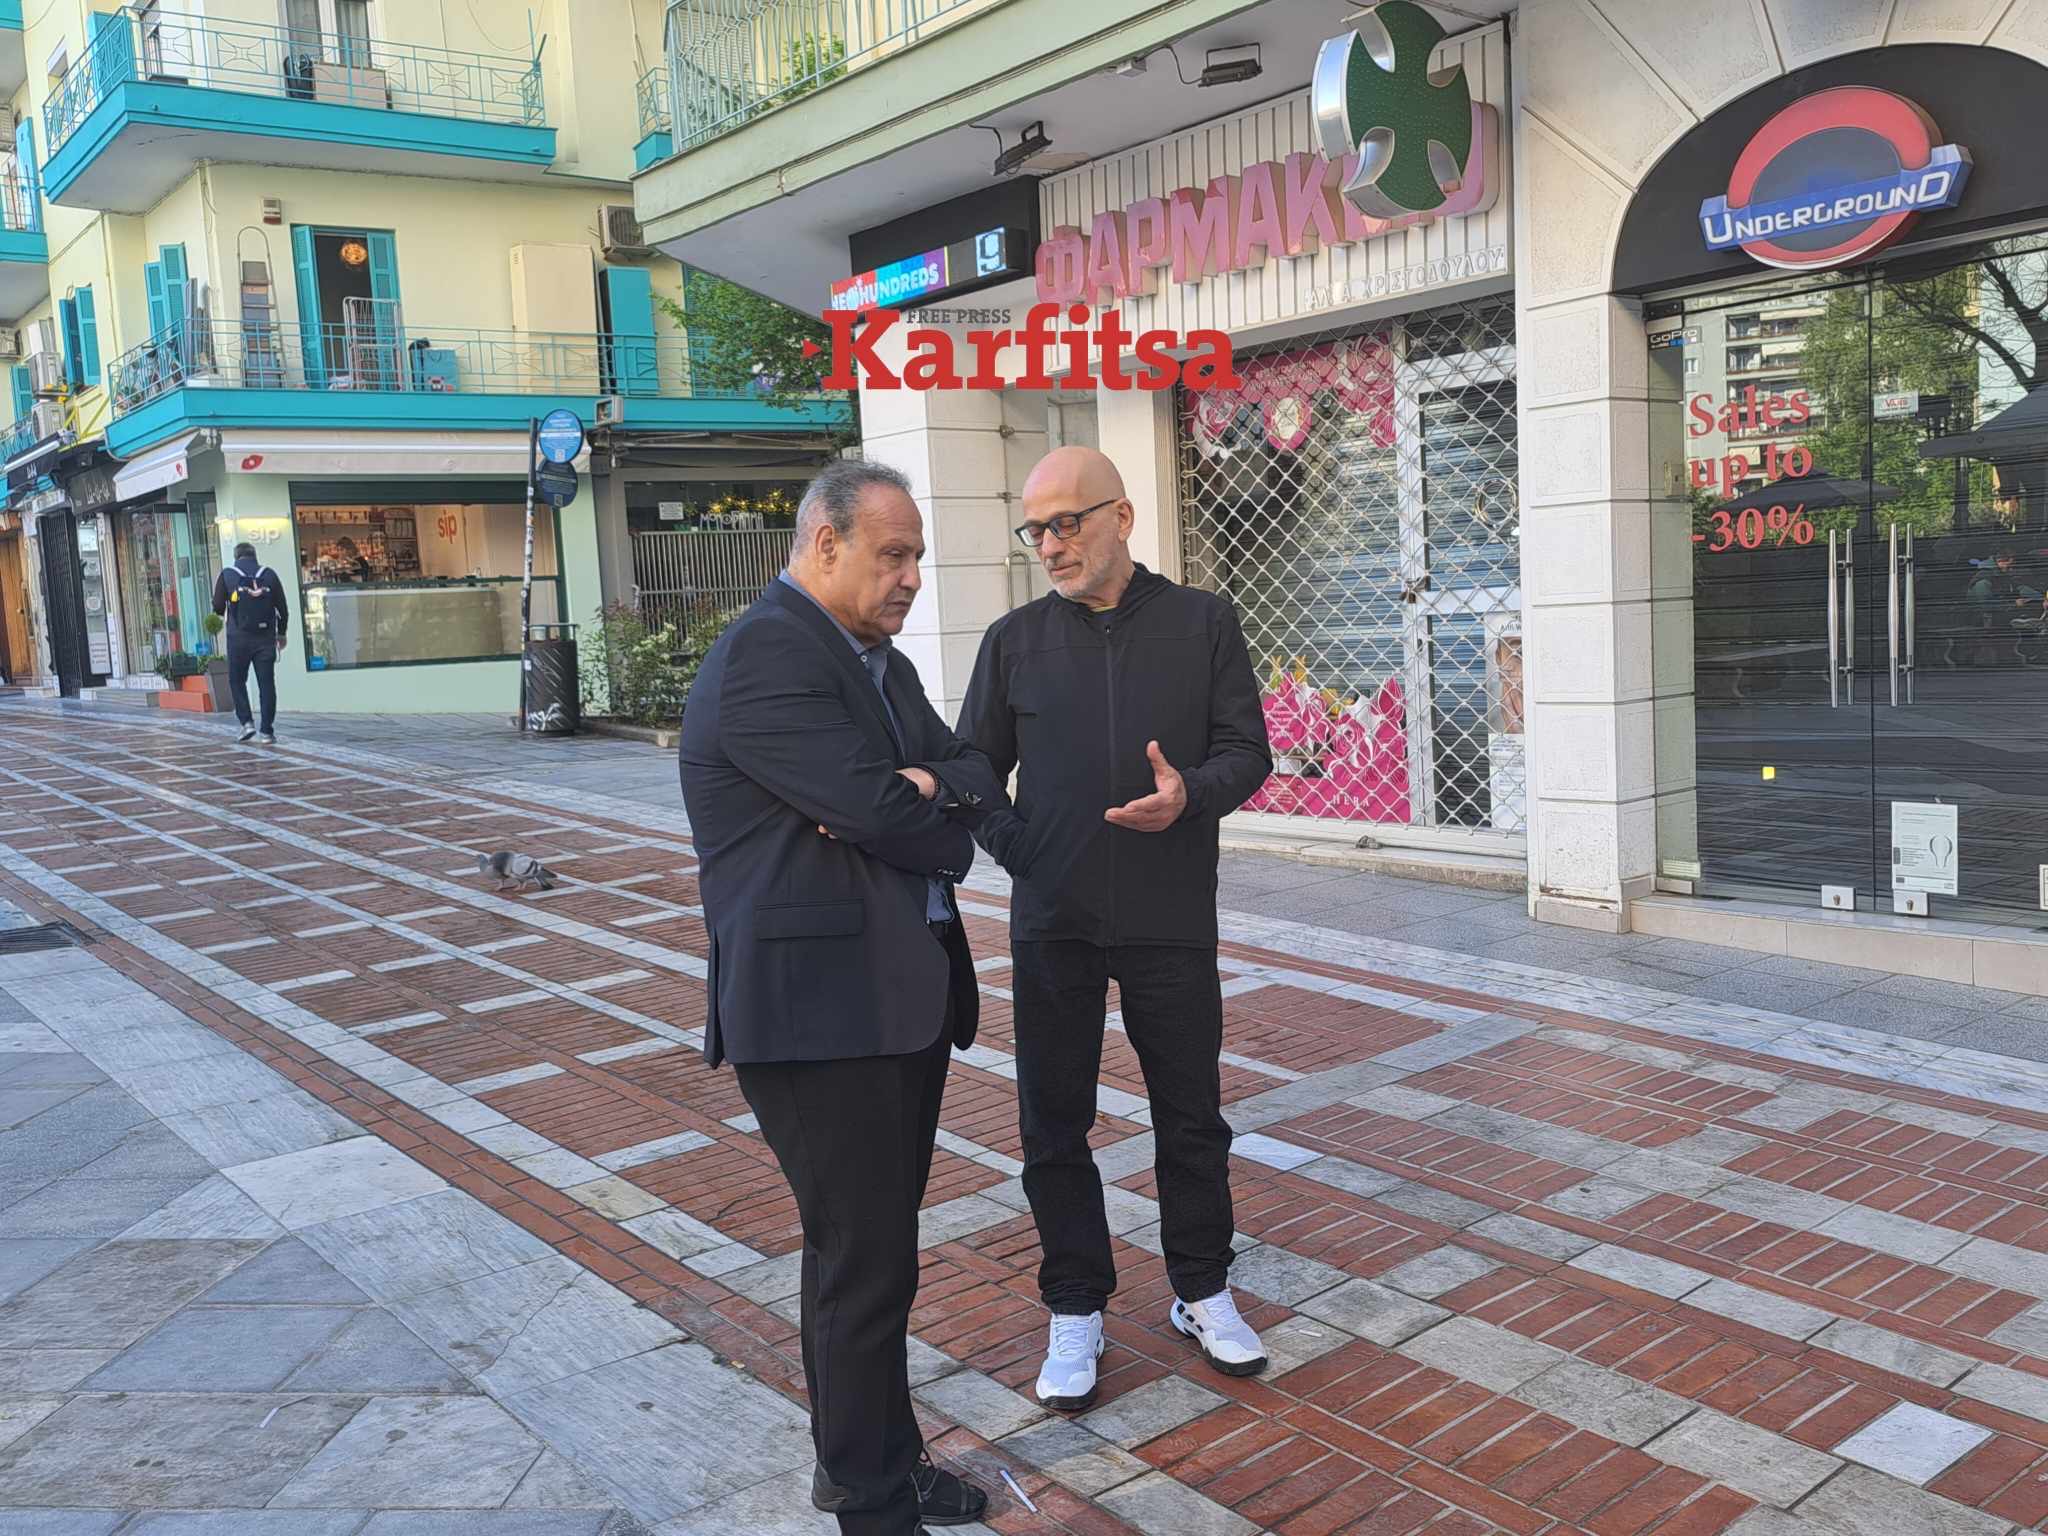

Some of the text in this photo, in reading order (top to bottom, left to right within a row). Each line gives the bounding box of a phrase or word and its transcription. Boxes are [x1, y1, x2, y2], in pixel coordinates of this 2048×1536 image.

[860, 262, 940, 306] HUNDREDS
[1650, 329, 1698, 344] GoPro
[1689, 384, 1811, 439] Sales
[1689, 442, 1814, 500] up to
[437, 509, 458, 544] sip
[1690, 503, 1815, 552] -30%
